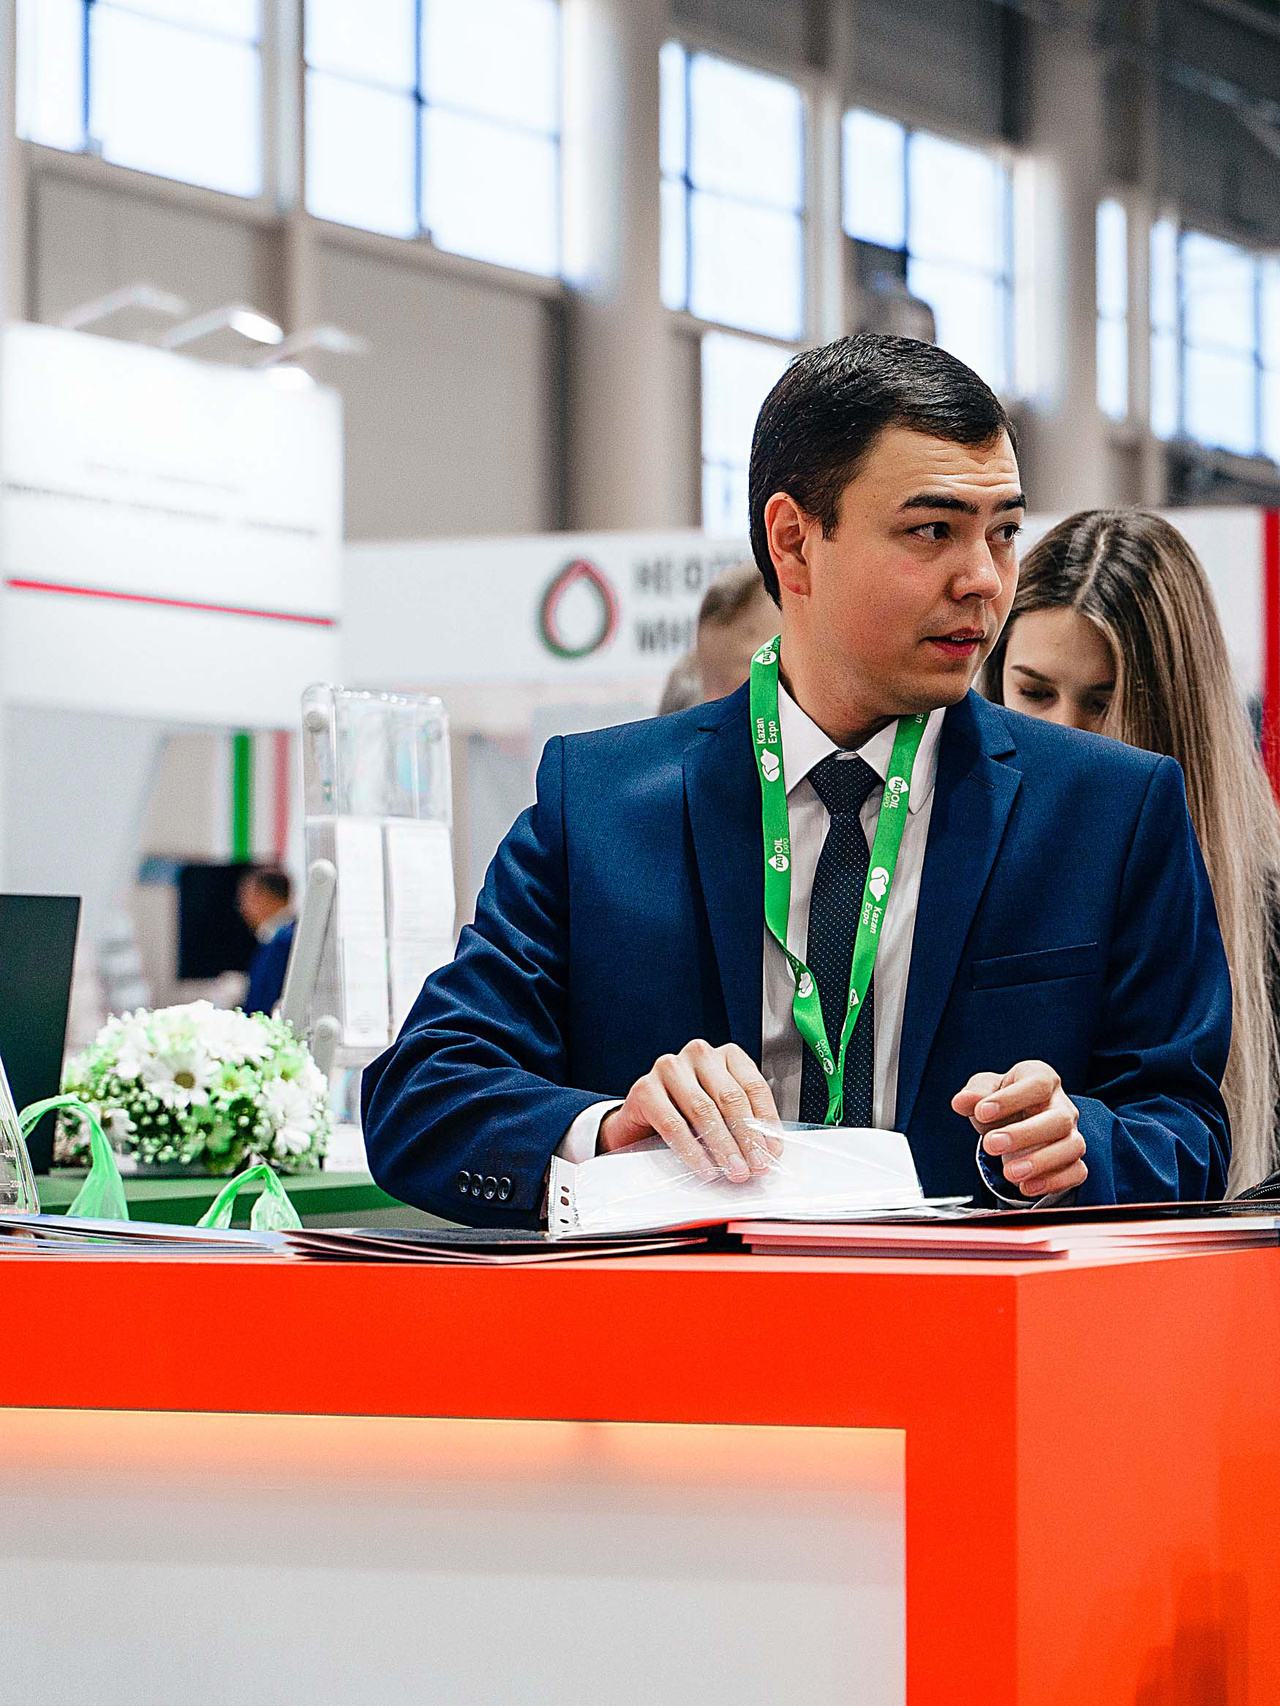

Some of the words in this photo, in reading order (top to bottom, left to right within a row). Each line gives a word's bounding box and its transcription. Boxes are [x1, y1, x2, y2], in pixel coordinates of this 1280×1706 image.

[756, 717, 766, 745] Kazan
[768, 720, 779, 744] Expo
[862, 902, 873, 925] Expo
[870, 906, 882, 935] Kazan
